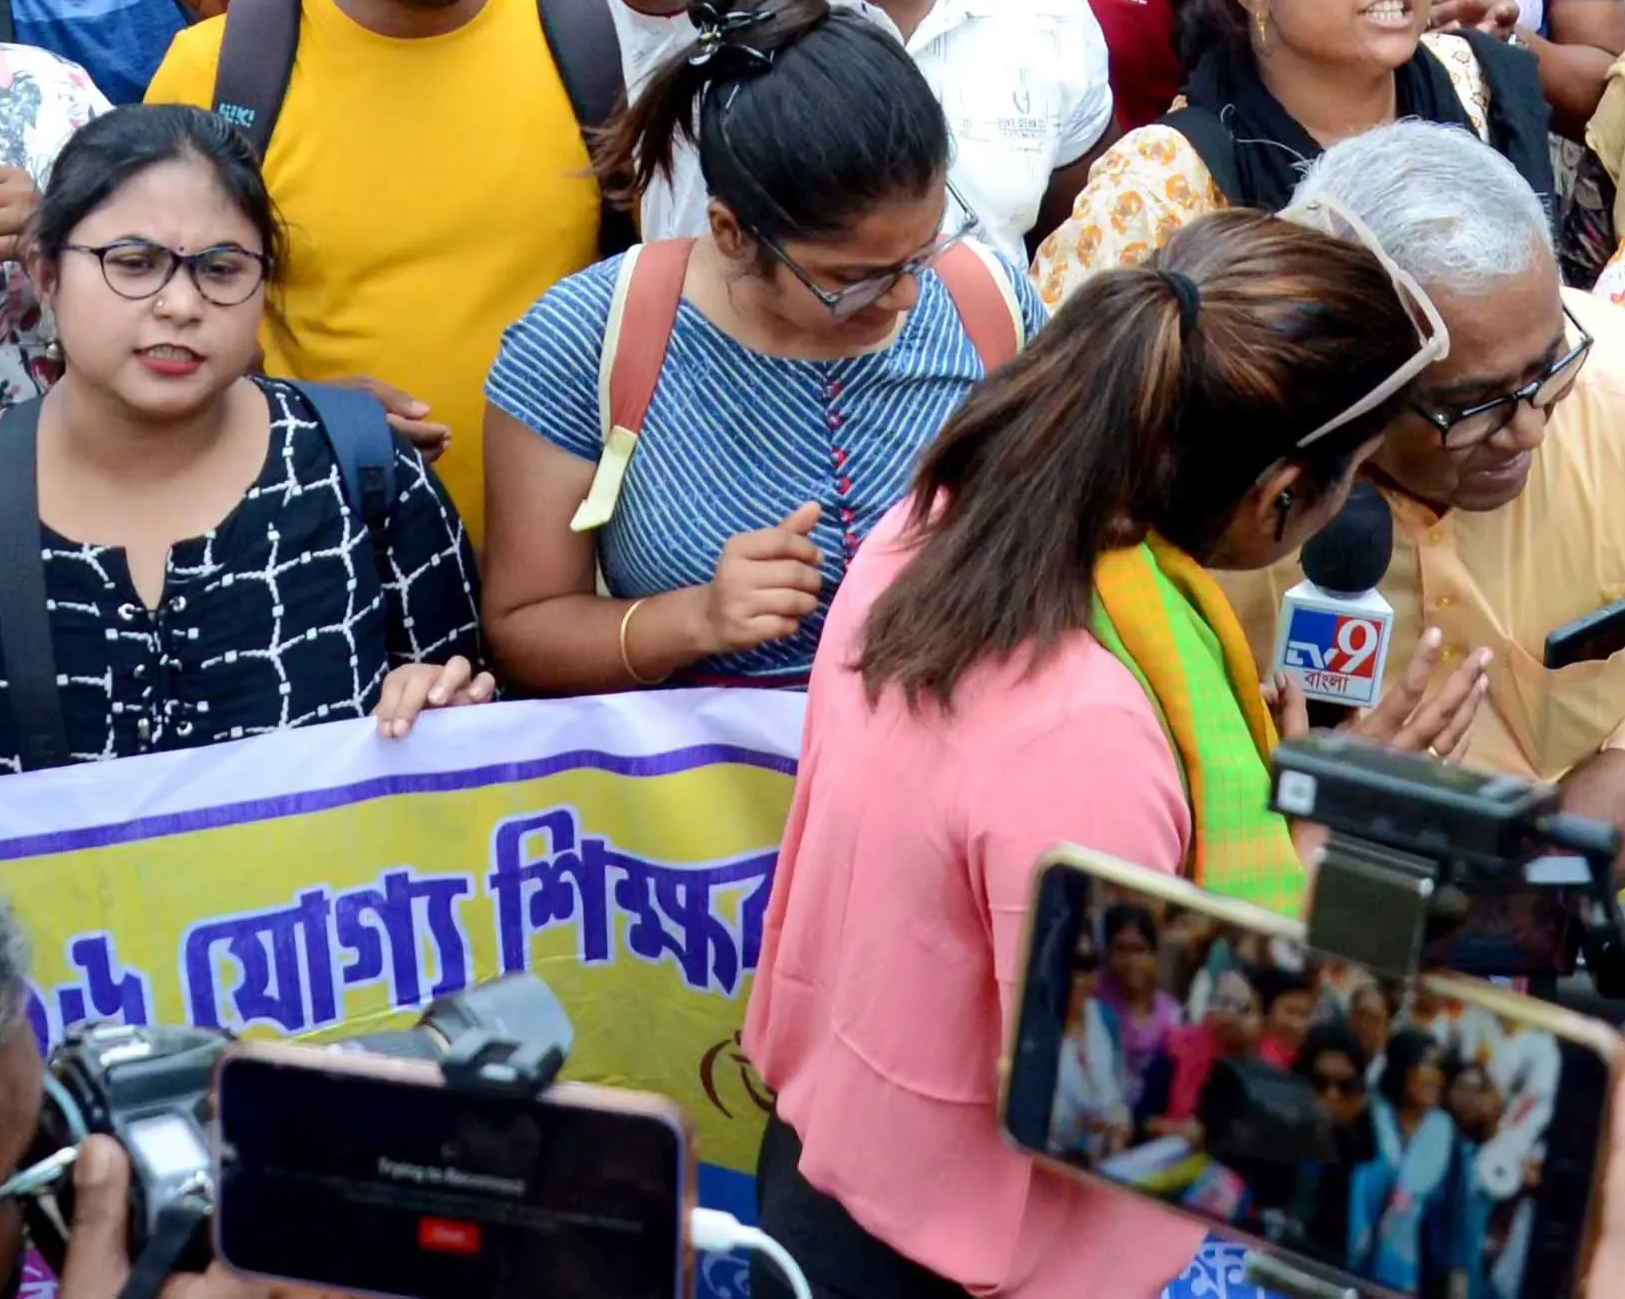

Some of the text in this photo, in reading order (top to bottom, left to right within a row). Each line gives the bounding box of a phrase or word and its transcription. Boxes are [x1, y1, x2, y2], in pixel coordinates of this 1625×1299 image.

[1286, 617, 1379, 674] TV9
[1302, 669, 1351, 694] বাংলা
[486, 807, 777, 995] শিক্ষ
